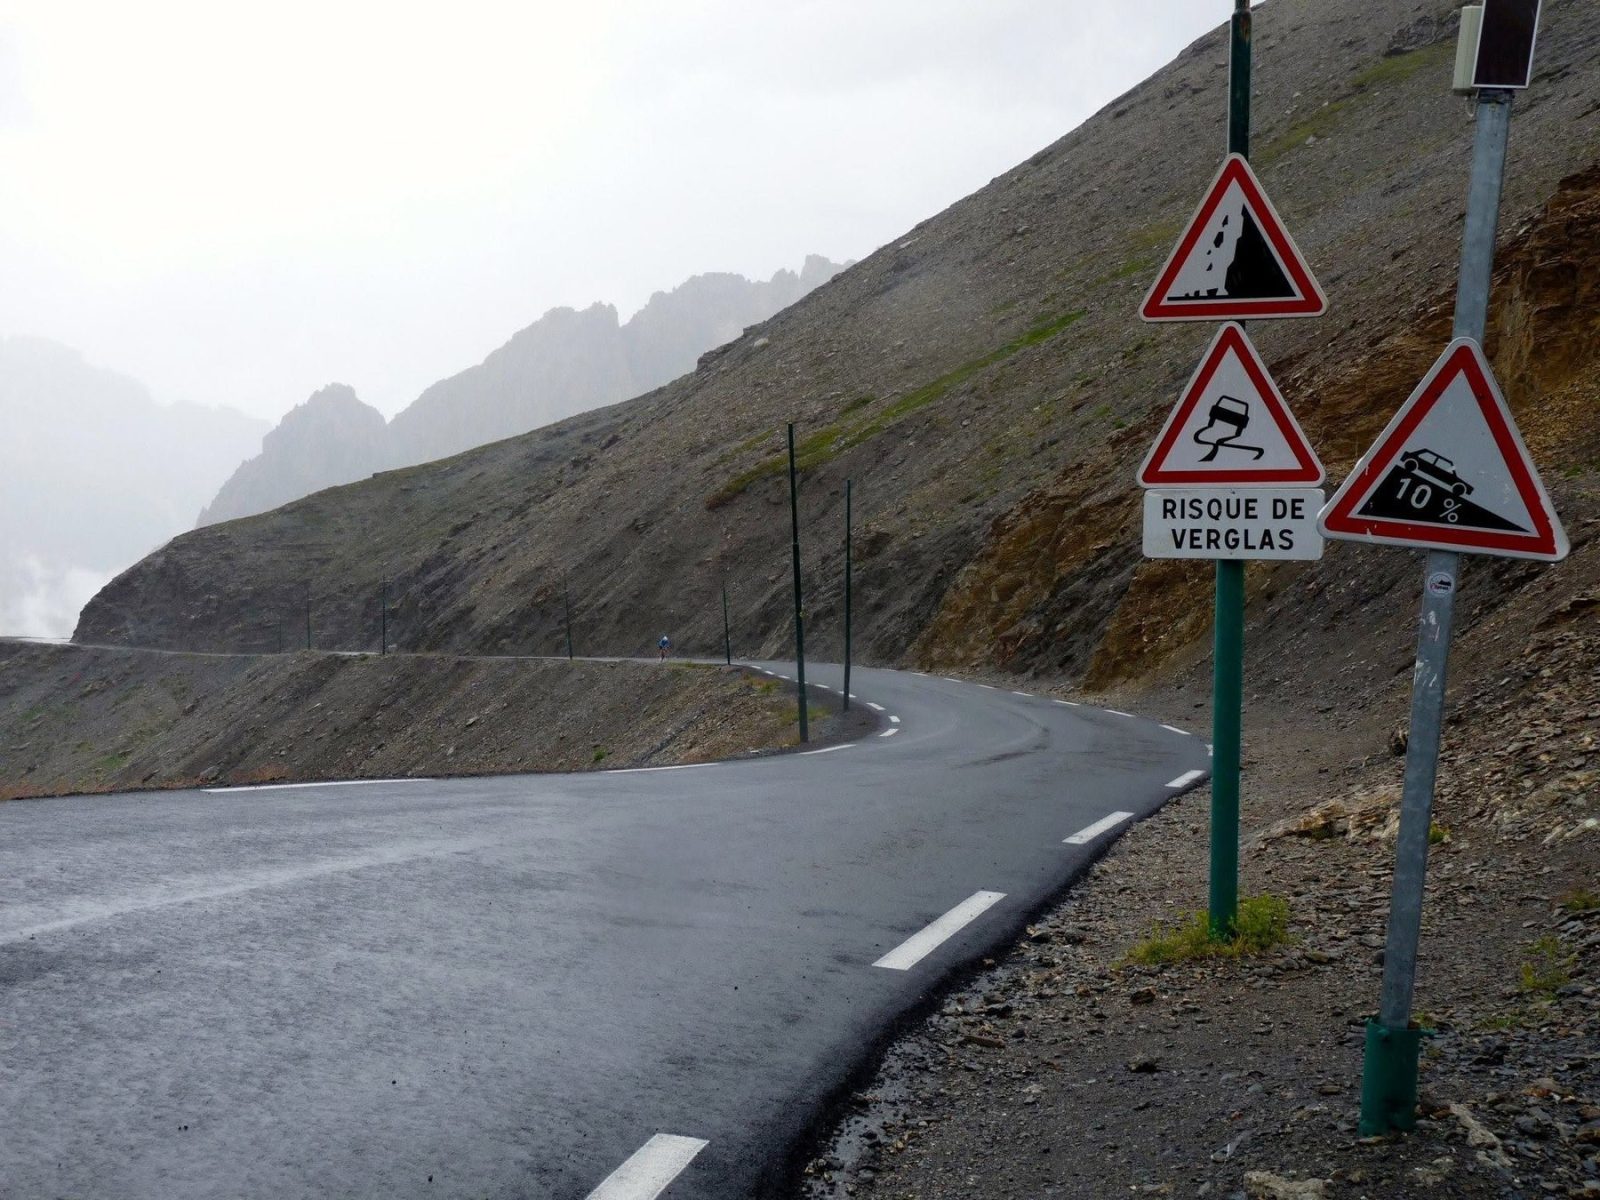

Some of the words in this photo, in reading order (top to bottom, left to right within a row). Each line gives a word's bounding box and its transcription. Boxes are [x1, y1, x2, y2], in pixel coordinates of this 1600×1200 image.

[1162, 498, 1258, 521] RISQUE
[1272, 498, 1305, 520] DE
[1171, 528, 1294, 551] VERGLAS
